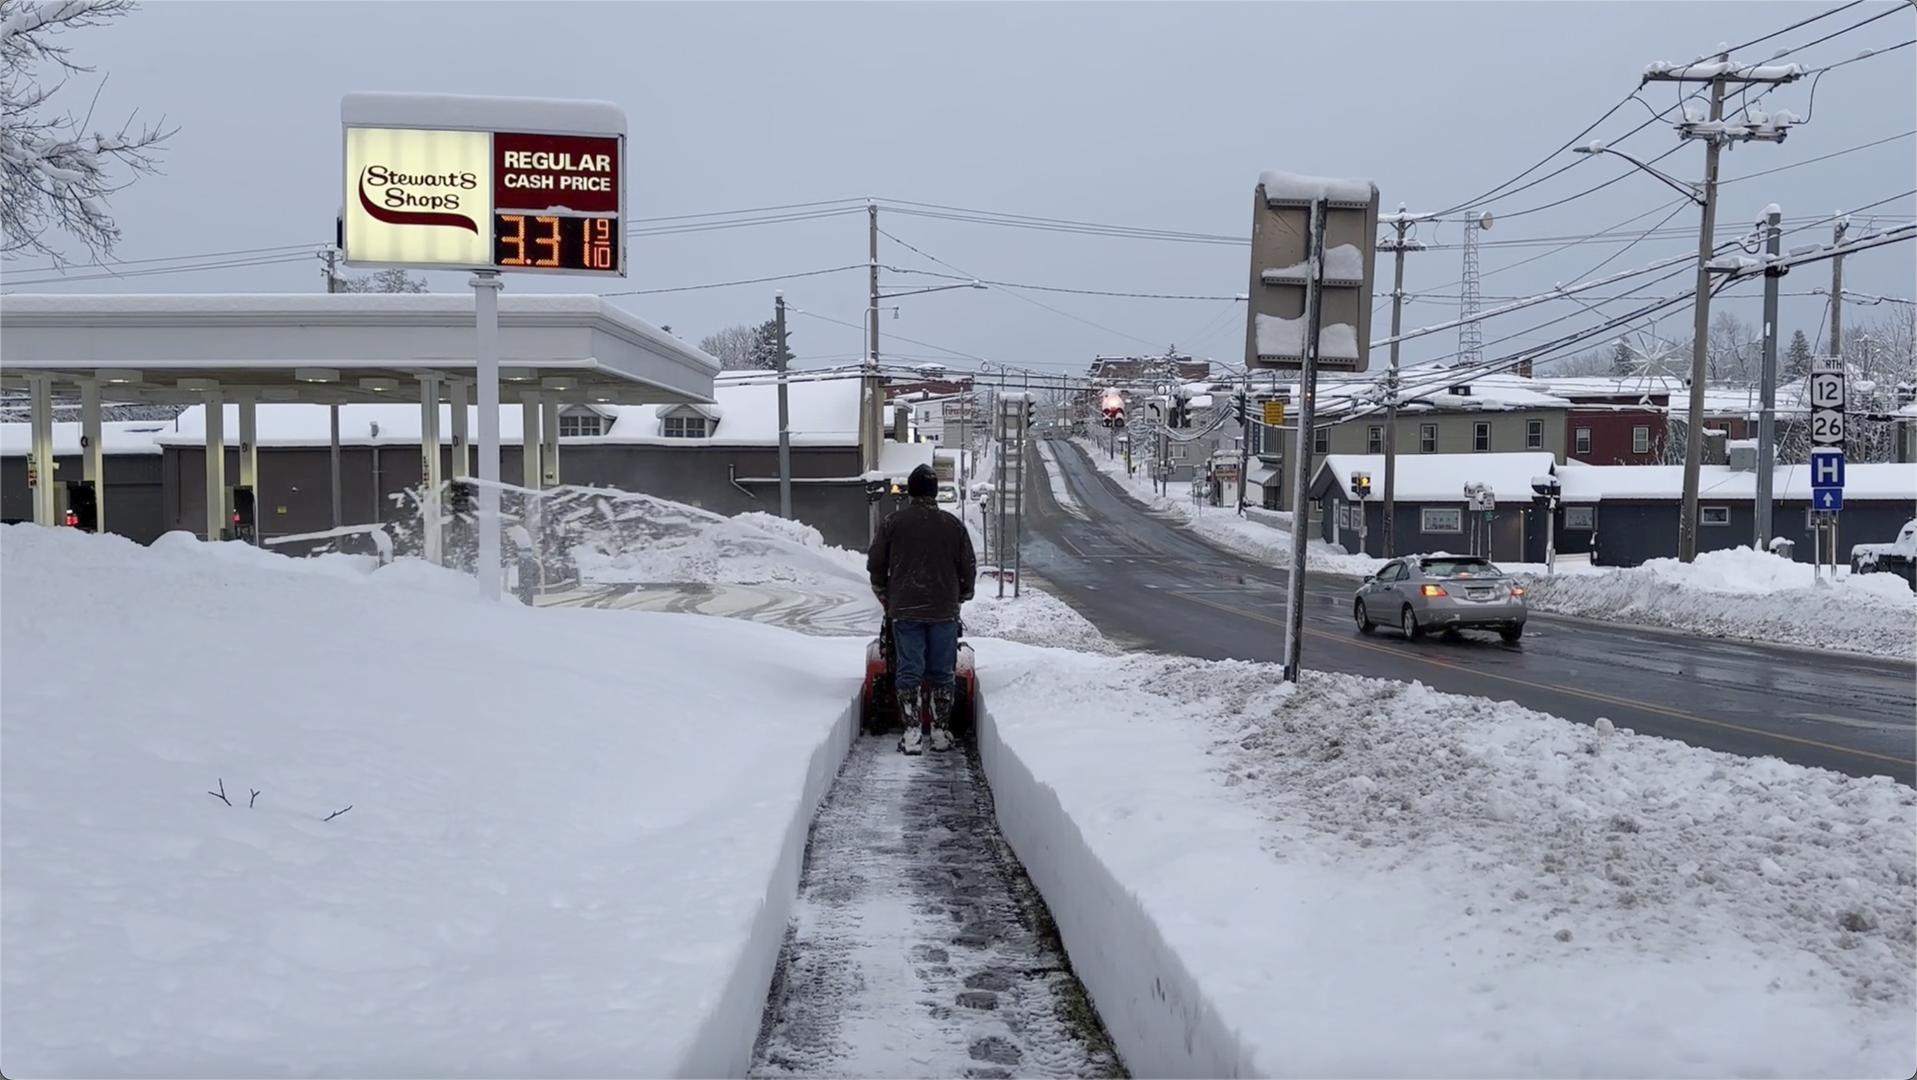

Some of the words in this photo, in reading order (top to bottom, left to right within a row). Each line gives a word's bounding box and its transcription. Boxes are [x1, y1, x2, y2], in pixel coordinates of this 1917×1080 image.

[504, 150, 611, 172] REGULAR
[367, 165, 477, 190] Stewart's
[504, 173, 554, 190] CASH
[560, 175, 611, 191] PRICE
[384, 187, 460, 210] Shops
[1813, 359, 1842, 369] RTH
[1818, 381, 1838, 400] 12
[1814, 417, 1842, 436] 26
[1817, 457, 1839, 483] H
